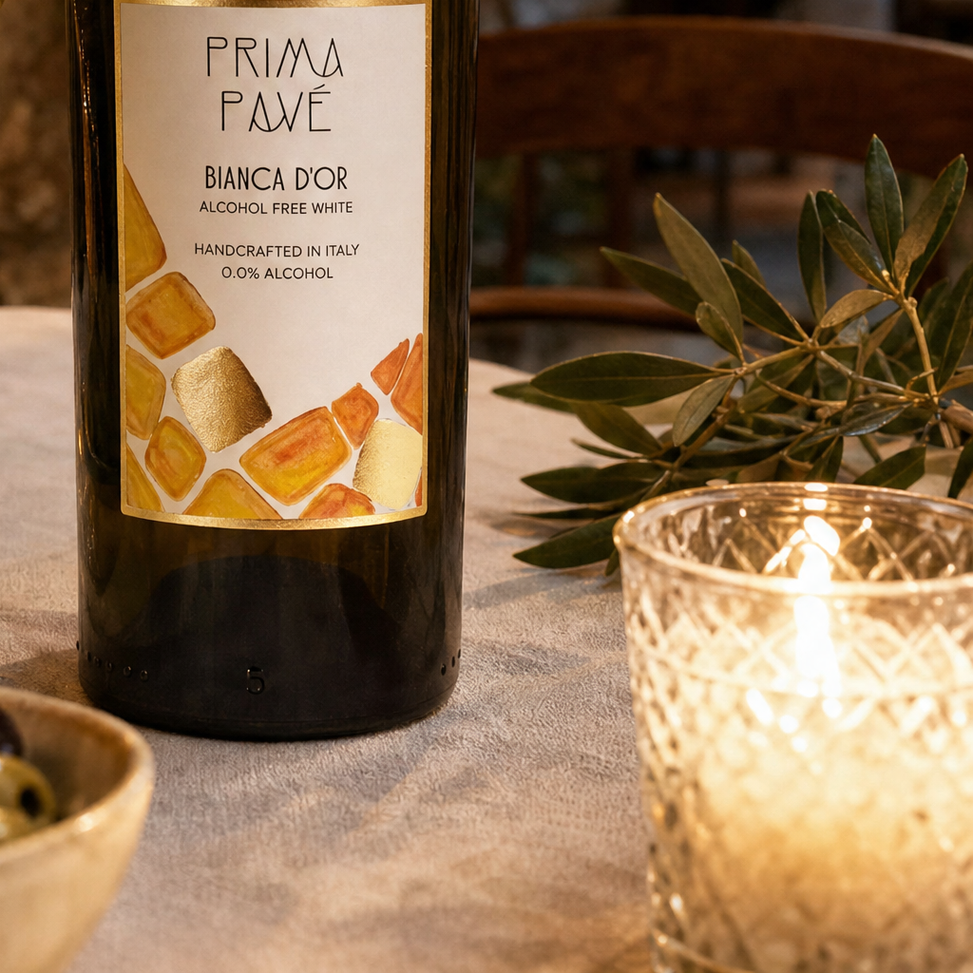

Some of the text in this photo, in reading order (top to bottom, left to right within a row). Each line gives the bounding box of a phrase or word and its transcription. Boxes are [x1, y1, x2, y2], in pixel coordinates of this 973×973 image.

[206, 36, 344, 78] PRIMA
[221, 83, 331, 132] PAVÉ
[205, 165, 348, 191] BIANCA D'OR
[199, 201, 353, 215] ALCOHOL FREE WHITE
[194, 243, 360, 258] HANDCRAFTED IN ITALY
[221, 266, 333, 280] 0.0% ALCOHOL
